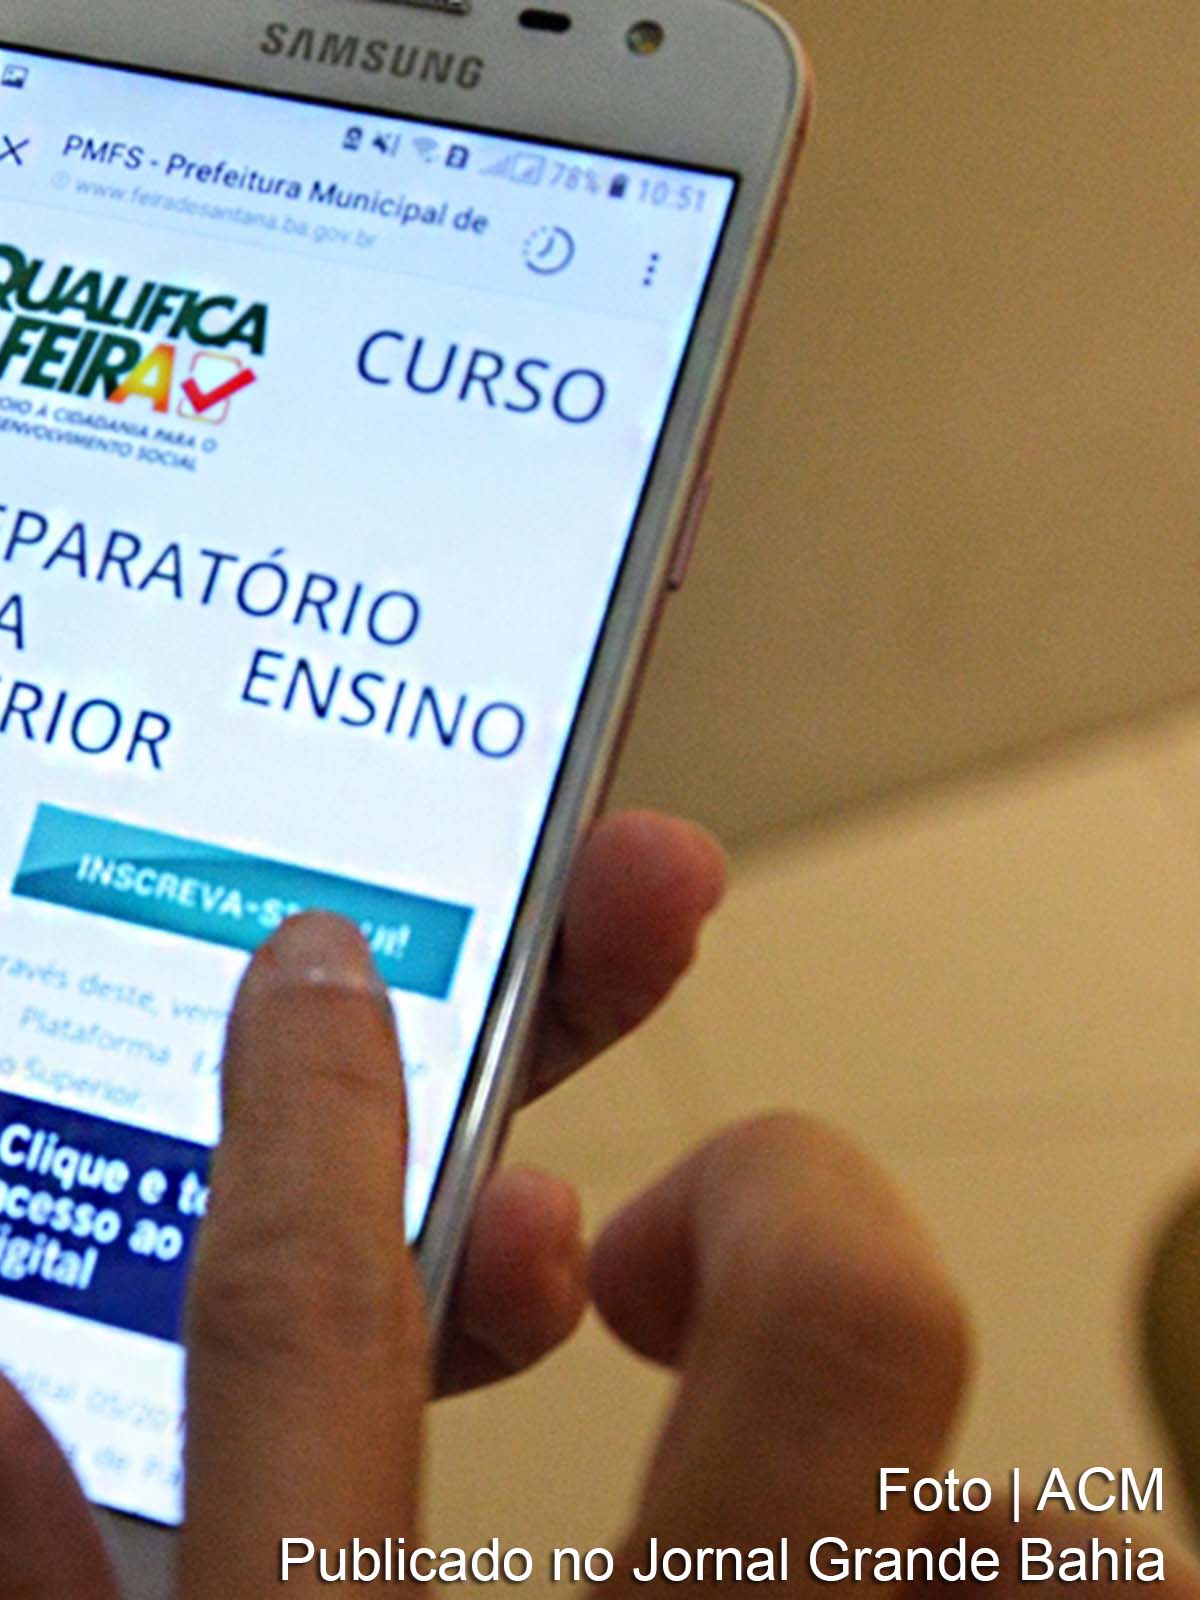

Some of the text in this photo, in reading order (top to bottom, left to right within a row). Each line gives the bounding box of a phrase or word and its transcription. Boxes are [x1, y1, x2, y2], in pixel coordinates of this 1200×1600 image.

[261, 21, 485, 91] SAMSUNG
[62, 133, 145, 170] PMFS
[165, 153, 301, 199] Prefeitura
[307, 179, 449, 226] Municipal
[453, 206, 489, 235] de
[550, 160, 708, 213] 78% 10:51
[355, 329, 607, 428] CURSO
[53, 407, 150, 439] CIDADANIA
[153, 427, 197, 449] PARA
[201, 437, 218, 454] O
[136, 446, 197, 473] SOCIAL
[240, 647, 526, 760] ENSINO
[19, 1004, 171, 1064] Plataforma
[137, 1168, 168, 1205] e
[128, 1217, 183, 1261] ao
